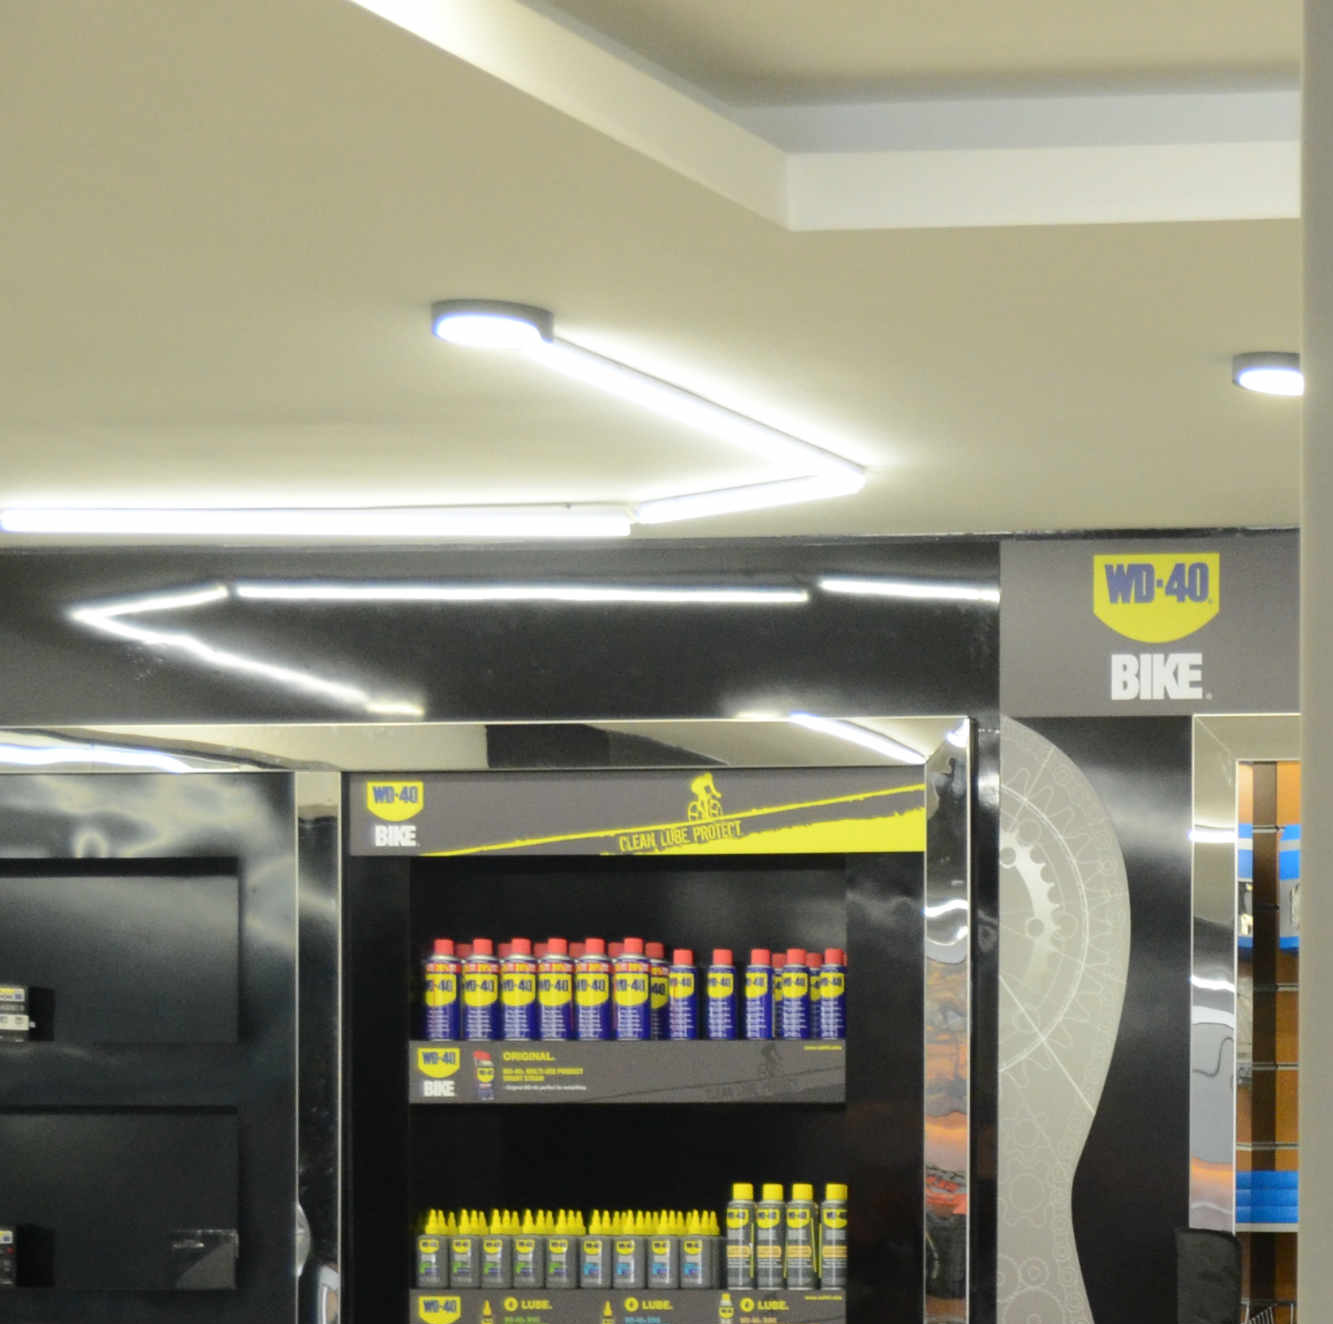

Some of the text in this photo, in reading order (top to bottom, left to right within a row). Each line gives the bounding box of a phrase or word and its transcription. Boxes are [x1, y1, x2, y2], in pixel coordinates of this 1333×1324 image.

[1104, 562, 1209, 604] WD-40
[1111, 653, 1203, 700] BIKE
[372, 785, 419, 804] WD-40
[375, 825, 417, 847] BIKE
